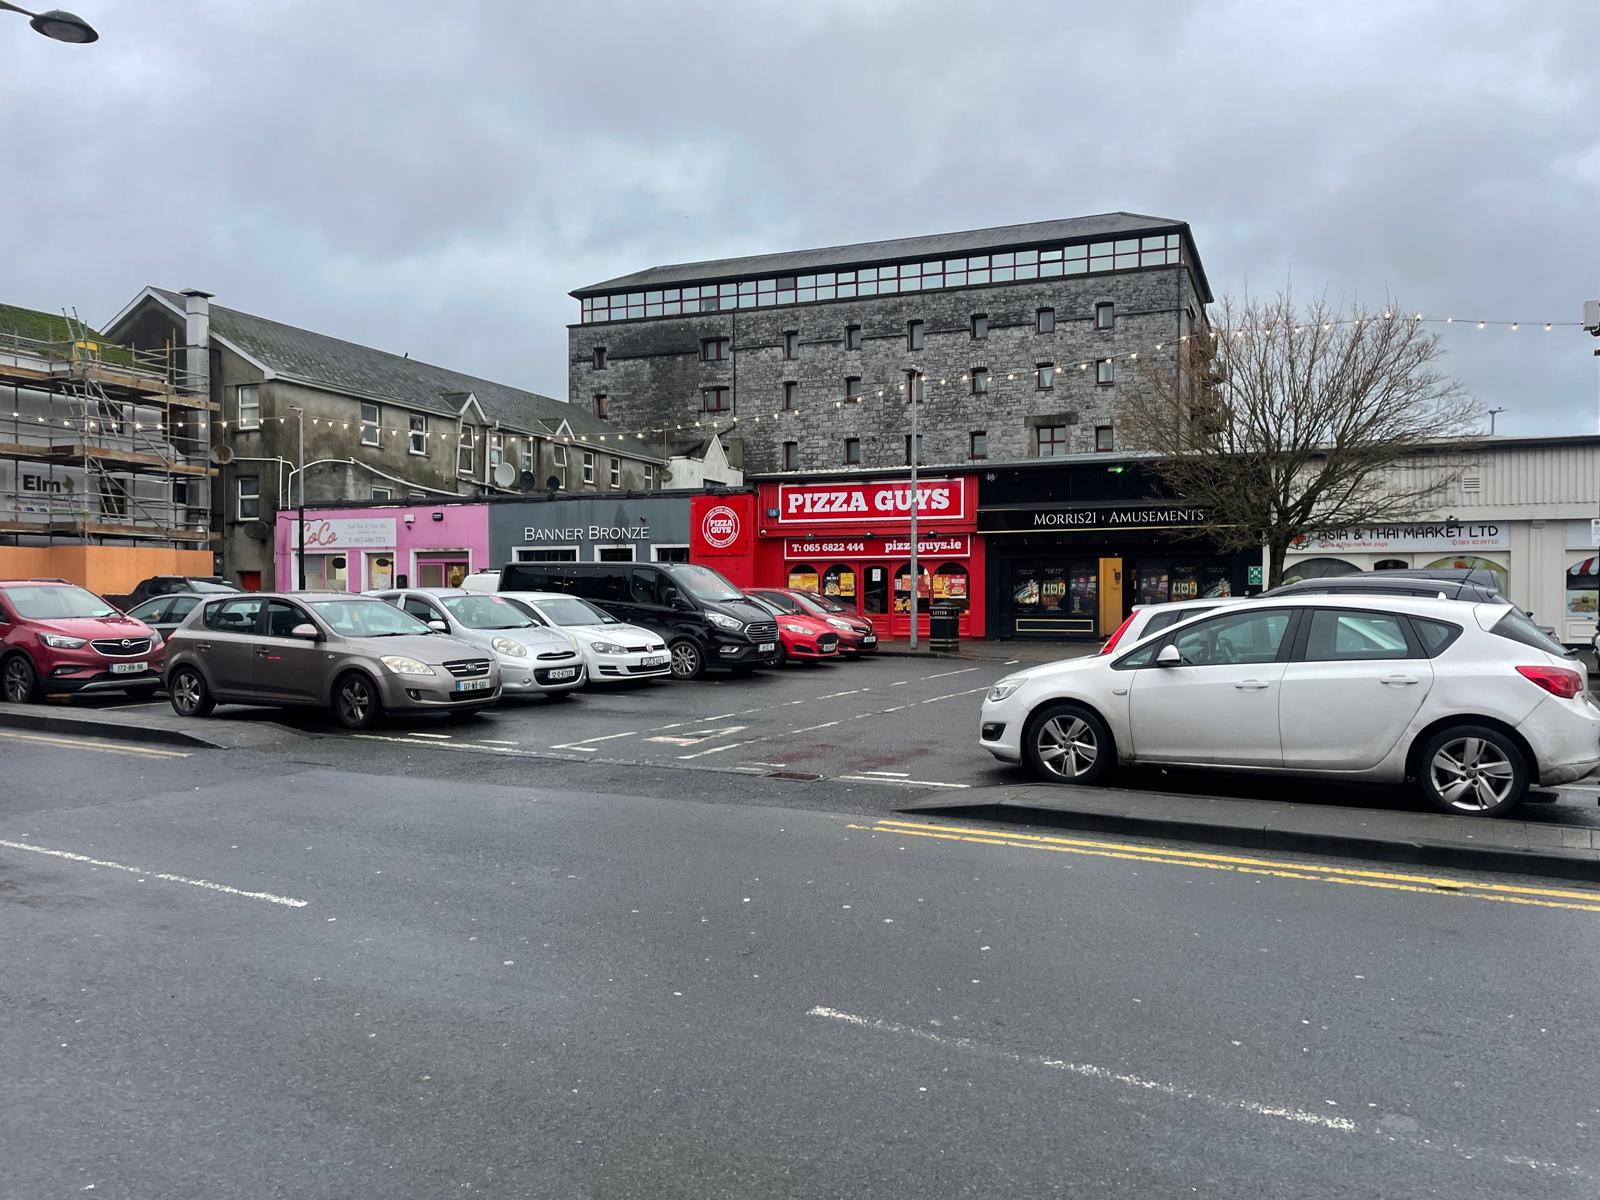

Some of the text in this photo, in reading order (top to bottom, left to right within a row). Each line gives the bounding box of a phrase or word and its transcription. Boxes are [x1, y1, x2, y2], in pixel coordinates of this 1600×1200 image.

[23, 474, 61, 493] Elm
[787, 488, 950, 514] PIZZA GUYS
[709, 519, 733, 527] PIZZA
[1034, 509, 1204, 526] MORRIS21 AMUSEMENTS
[524, 525, 650, 541] BANNER BRONZE
[1317, 525, 1499, 541] ASIA & THAI MARKET LTD
[792, 538, 962, 553] T: 065 6822 444 pizzguys.ie
